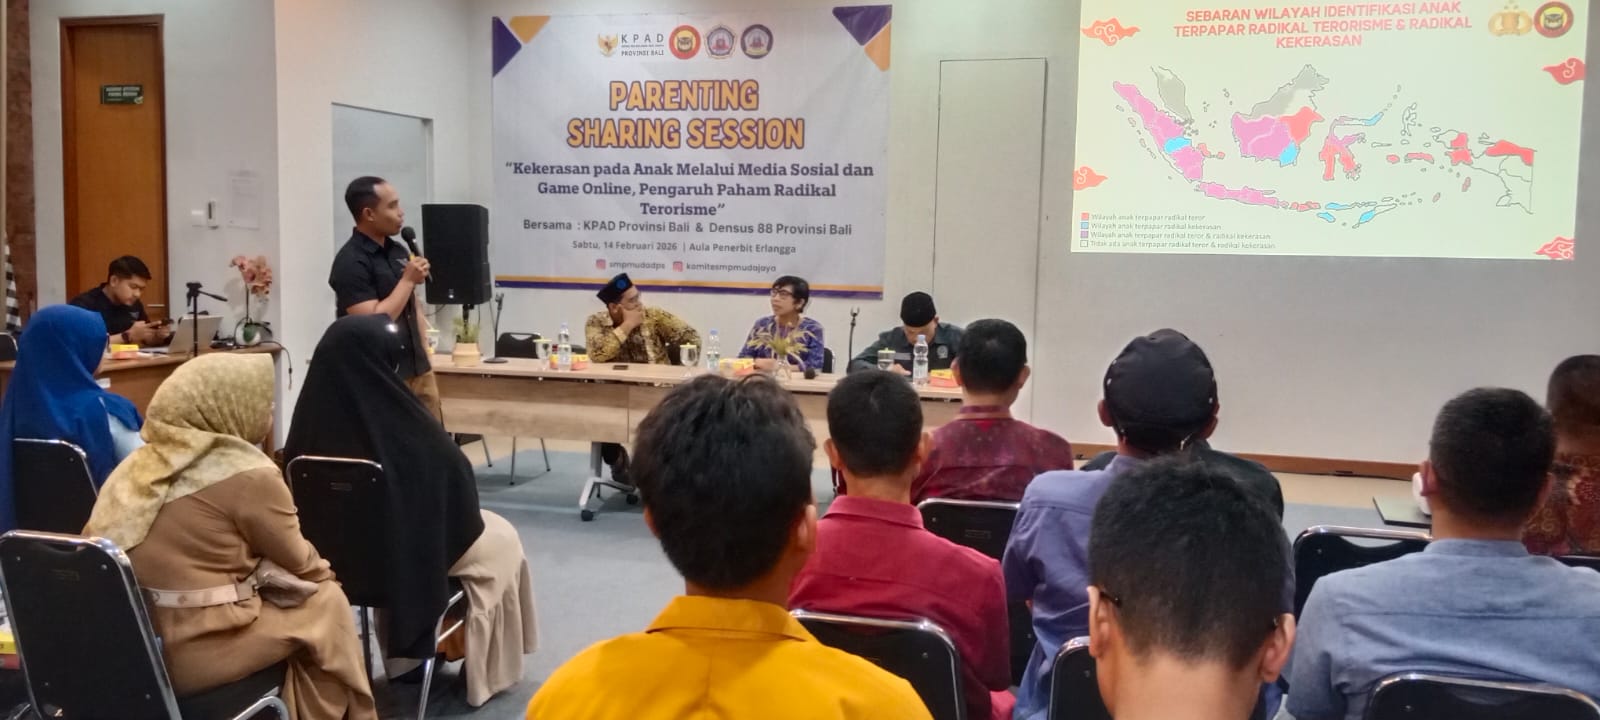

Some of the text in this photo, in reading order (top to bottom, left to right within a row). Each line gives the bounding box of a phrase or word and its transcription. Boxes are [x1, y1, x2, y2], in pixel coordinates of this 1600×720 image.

[1186, 1, 1462, 22] SEBARAN WILAYAH IDENTIFIKASI ANAK
[1174, 16, 1473, 37] TERPAPAR RADIKAL TERORISME & RADIKAL
[1276, 34, 1362, 48] KEKERASAN
[608, 79, 760, 111] PARENTING
[566, 117, 805, 149] SHARING SESSION
[593, 162, 630, 178] pada
[633, 162, 673, 176] Anak
[676, 162, 734, 176] Melalui
[738, 162, 787, 176] Media
[790, 162, 839, 177] Sosial
[842, 163, 874, 177] dan
[537, 182, 836, 199] Game Online, Pengaruh Paham Radikal
[1091, 214, 1117, 222] Wilayah
[1136, 214, 1163, 222] terpapar
[523, 219, 573, 231] Bersama
[583, 221, 616, 232] KPAD
[619, 221, 666, 233] Provinsi
[668, 221, 690, 233] Bali
[695, 223, 704, 233] &
[709, 223, 754, 234] Densus
[757, 223, 773, 234] 88
[776, 223, 827, 236] Provinsi
[829, 224, 852, 236] Bali
[1091, 223, 1117, 231] Wilayah
[1135, 223, 1163, 231] terpapar
[1188, 223, 1222, 231] kekerasan
[1091, 232, 1117, 240] Wilayah
[1135, 232, 1163, 240] terpapar
[1213, 233, 1236, 241] radikal
[1237, 233, 1271, 241] kekerasan
[572, 240, 600, 250] Sabtu,
[603, 241, 613, 250] 14
[616, 241, 654, 251] Februari
[656, 242, 678, 251] 2026
[689, 243, 710, 251] Aula
[713, 243, 753, 253] Penerbit
[755, 244, 797, 255] Erlangga
[609, 261, 666, 270] smpmudadps
[686, 263, 777, 273] komitesmpmudajaya
